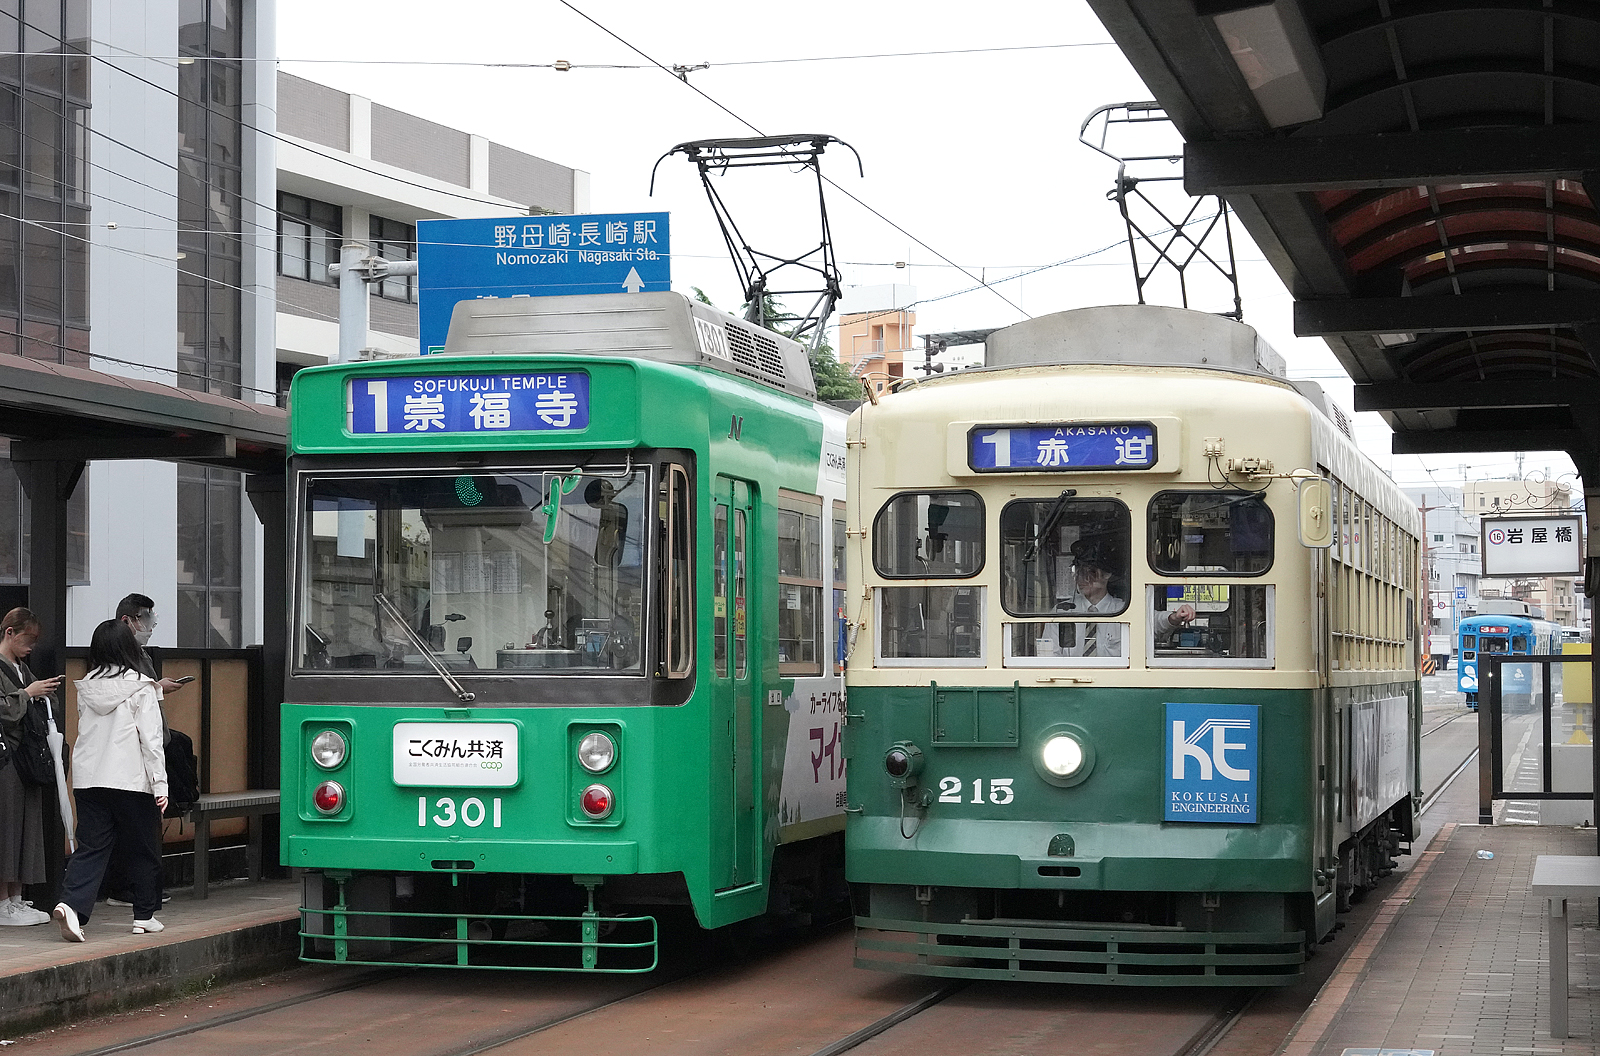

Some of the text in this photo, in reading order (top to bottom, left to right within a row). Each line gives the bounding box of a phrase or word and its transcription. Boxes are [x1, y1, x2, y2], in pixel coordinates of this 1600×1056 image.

[496, 247, 660, 266] Nomozaki Nagasaki Sta.
[697, 320, 728, 358] 1301
[413, 375, 567, 393] SOFUKUJI TEMPLE
[367, 380, 388, 433] 1
[403, 390, 578, 431] 崇福寺
[1054, 426, 1130, 437] AKASAKO
[982, 429, 1011, 467] 1
[1036, 435, 1148, 467] 赤迫
[1492, 532, 1502, 541] 16
[1507, 526, 1572, 544] 岩屋橋
[408, 739, 504, 759] こくみん共済
[1172, 718, 1251, 781] KE
[938, 776, 1015, 805] 215
[1171, 791, 1249, 802] KOKUSAI
[418, 796, 502, 828] 1301
[1171, 803, 1251, 814] ENGINEERING
